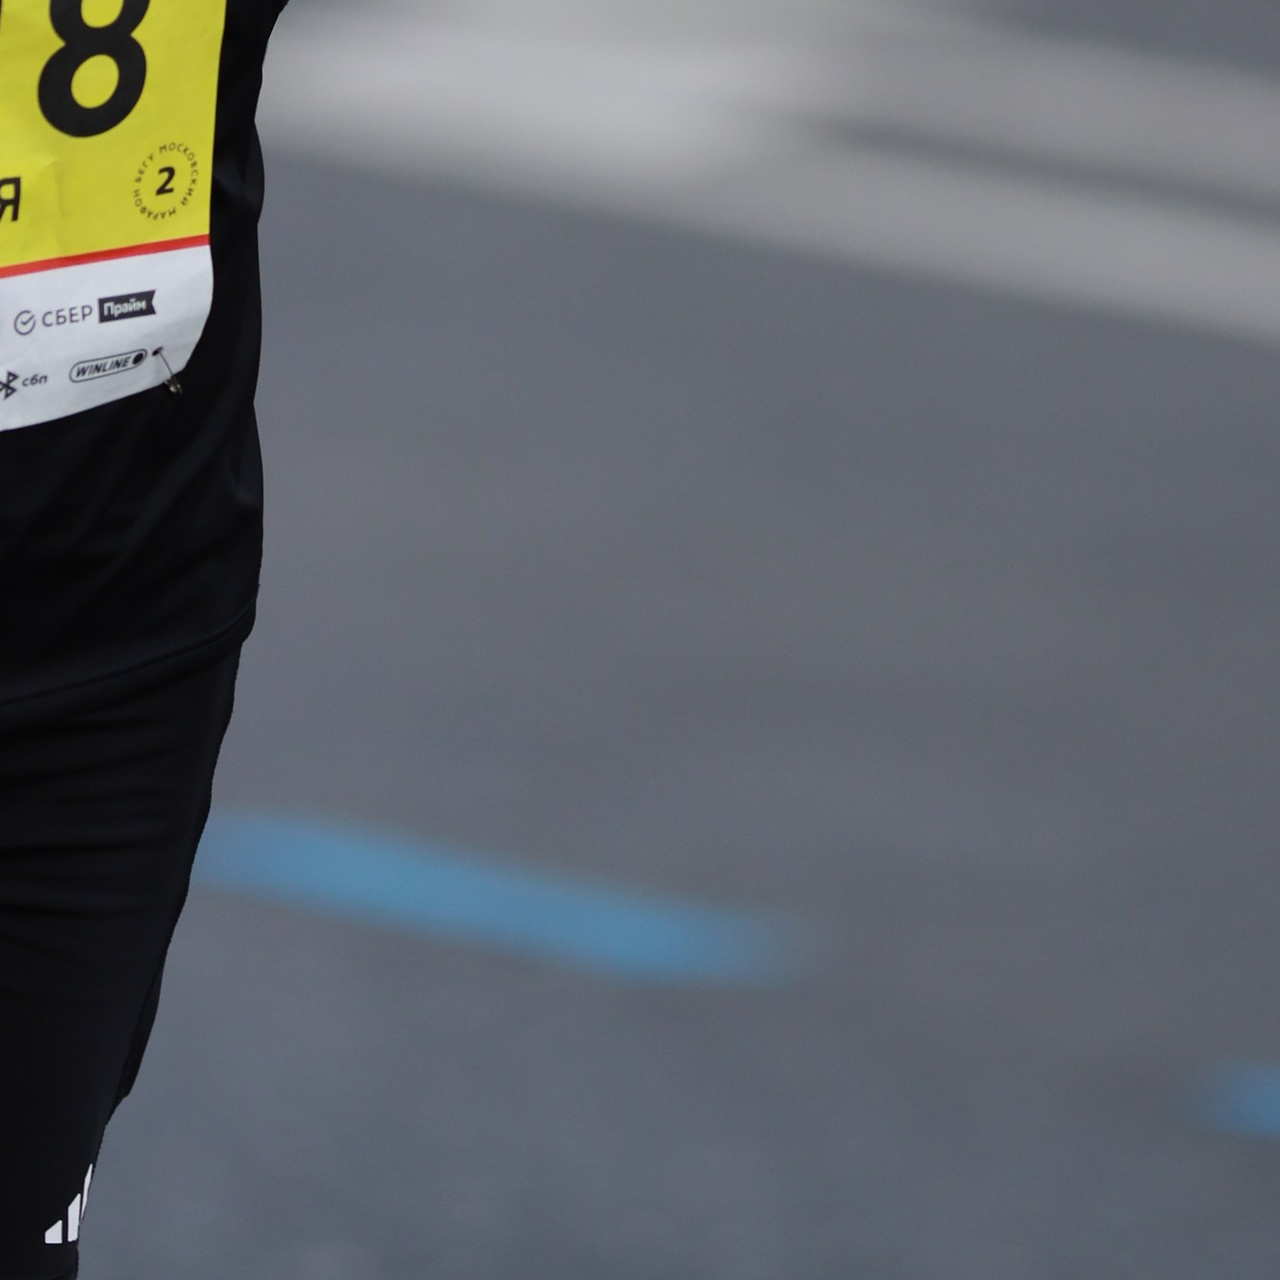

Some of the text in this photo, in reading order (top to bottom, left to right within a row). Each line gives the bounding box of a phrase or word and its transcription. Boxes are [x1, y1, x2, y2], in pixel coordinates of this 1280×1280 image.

[155, 166, 176, 197] 2
[41, 297, 147, 327] СБЕР Прайм
[75, 355, 132, 378] WINLINE
[22, 374, 49, 388] сбп
